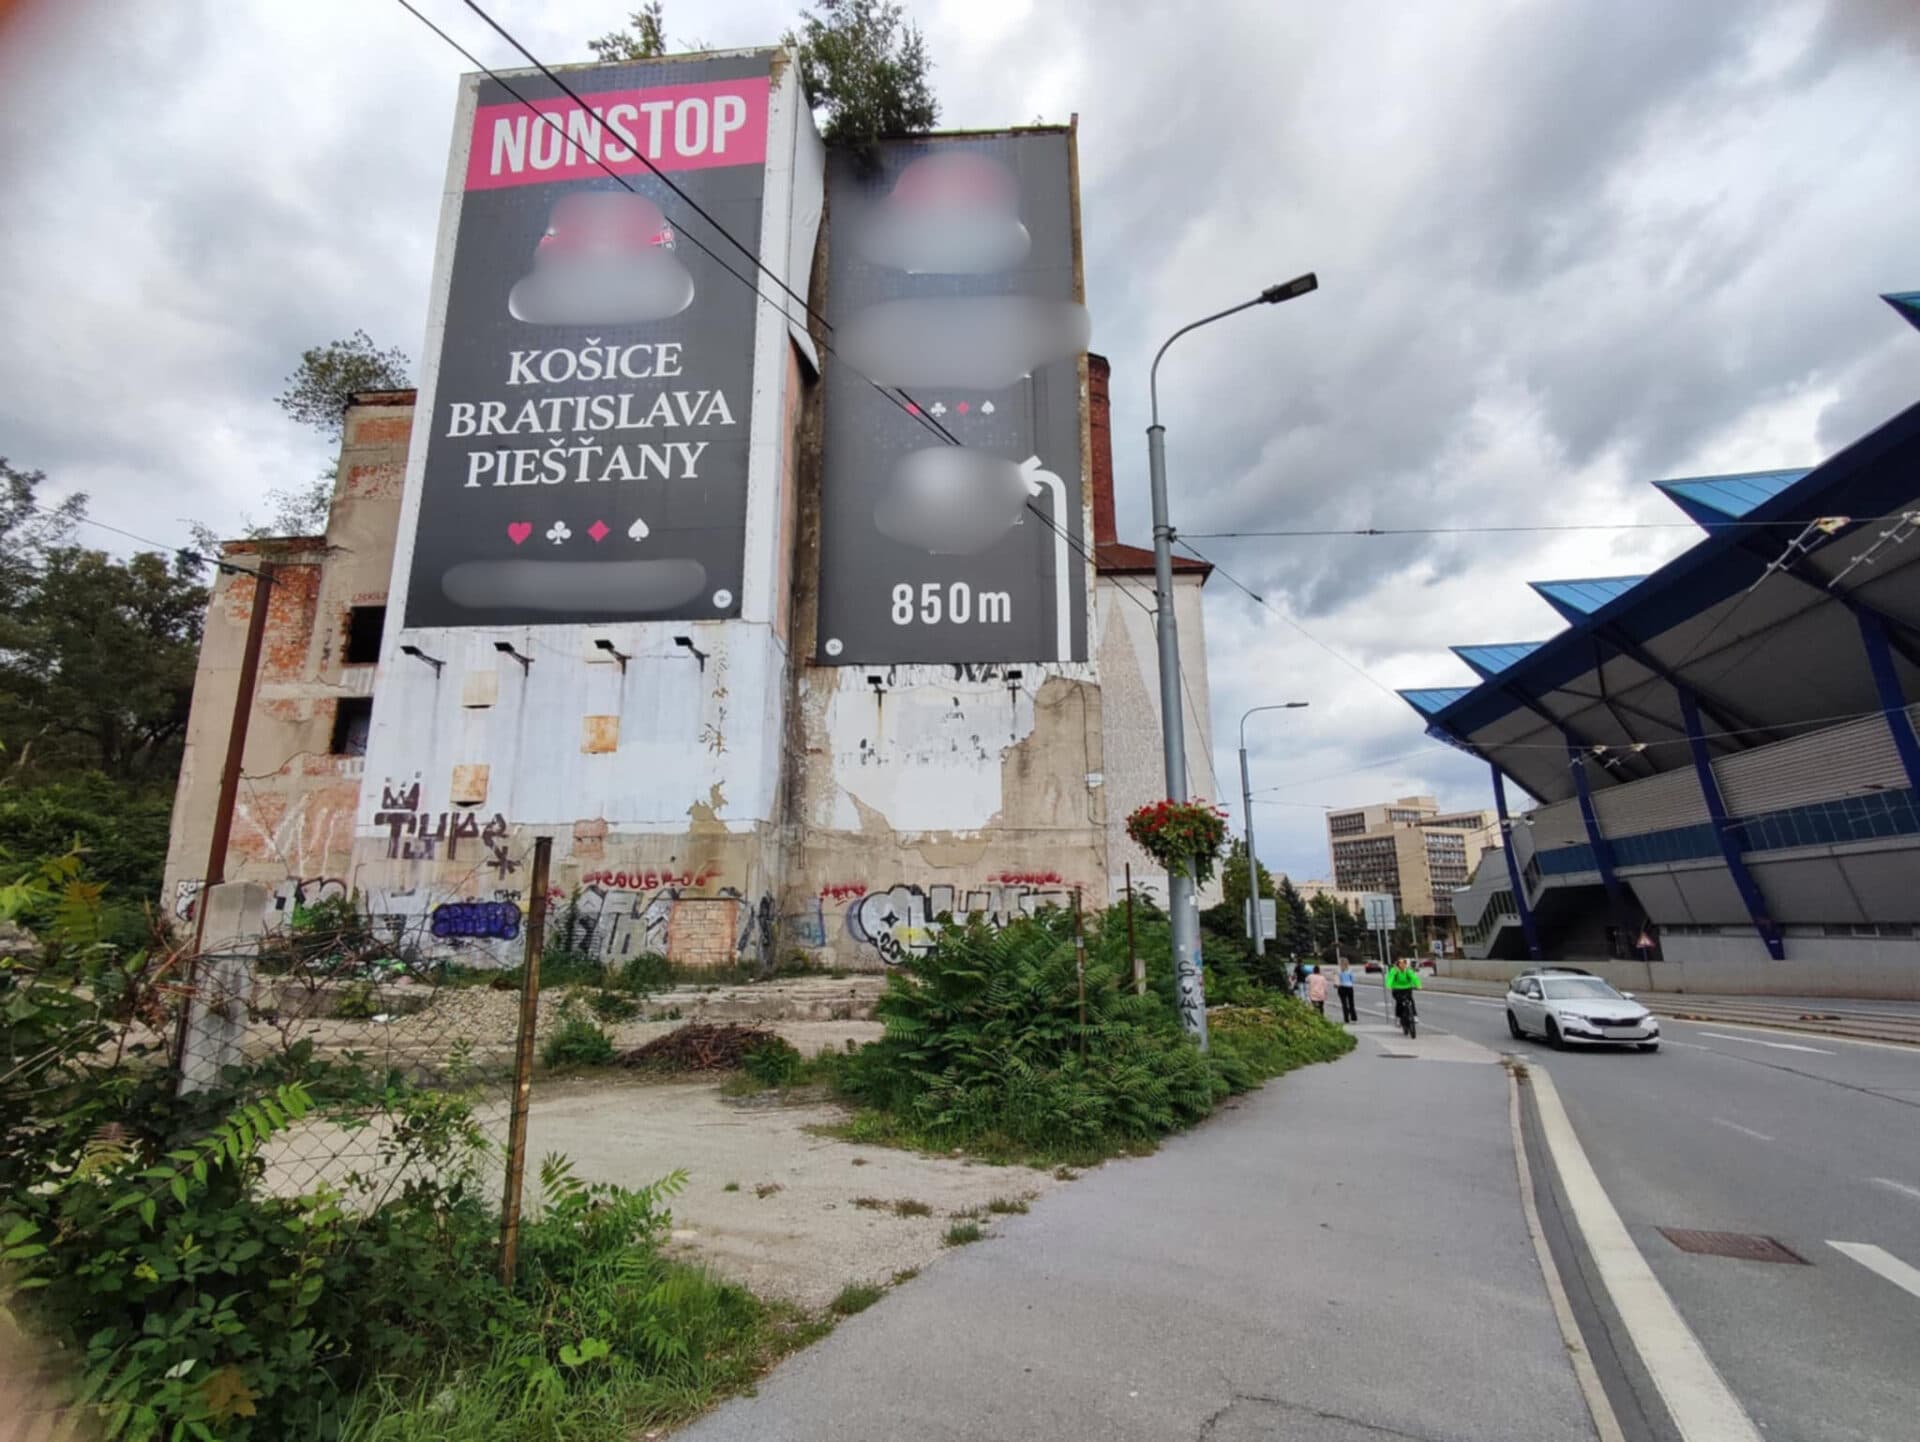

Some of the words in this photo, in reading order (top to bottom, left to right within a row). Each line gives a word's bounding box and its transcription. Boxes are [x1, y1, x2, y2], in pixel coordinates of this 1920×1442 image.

[489, 95, 747, 177] NONSTOP
[505, 337, 684, 386] KOŠICE
[445, 389, 737, 438] BRATISLAVA
[463, 436, 710, 488] PIEŠŤANY
